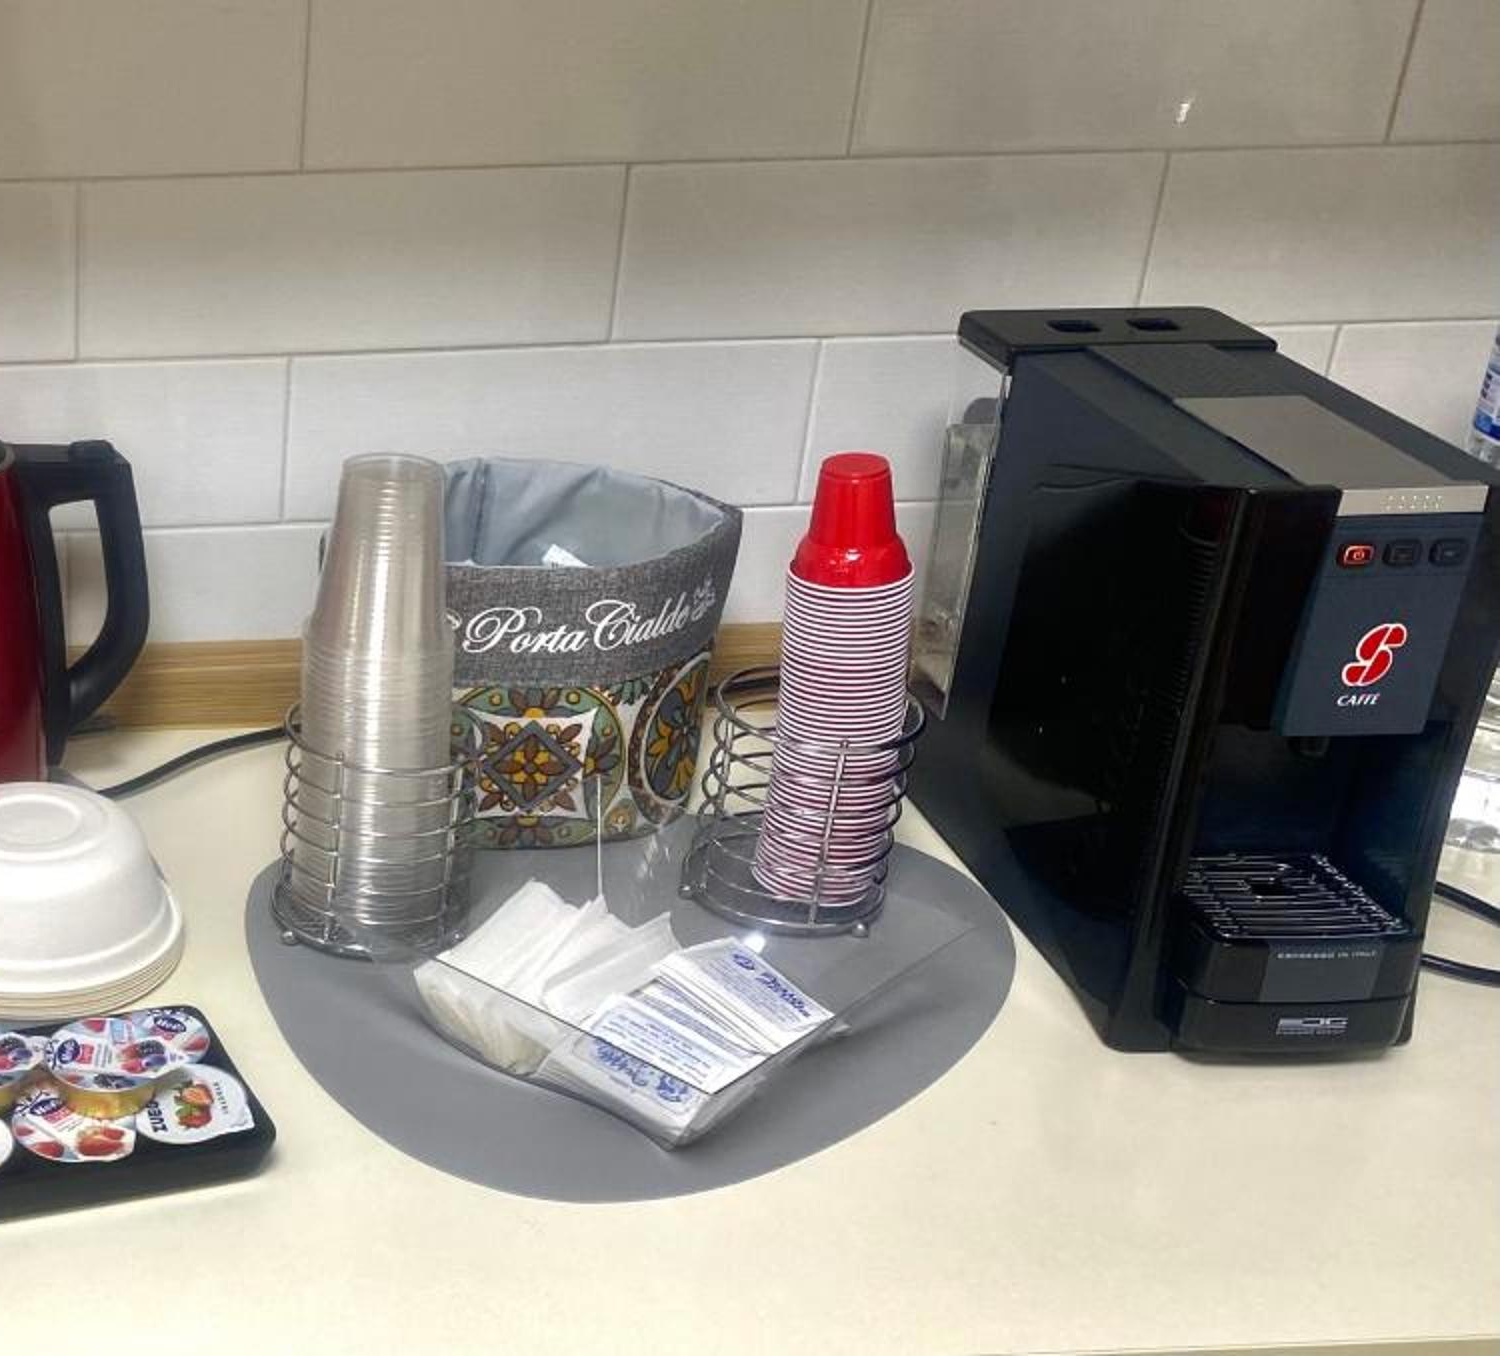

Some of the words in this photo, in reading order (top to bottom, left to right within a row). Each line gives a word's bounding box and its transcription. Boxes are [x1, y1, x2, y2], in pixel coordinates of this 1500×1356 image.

[462, 606, 588, 653] Porta
[586, 592, 688, 651] Cialde
[148, 1101, 169, 1133] ZUEG
